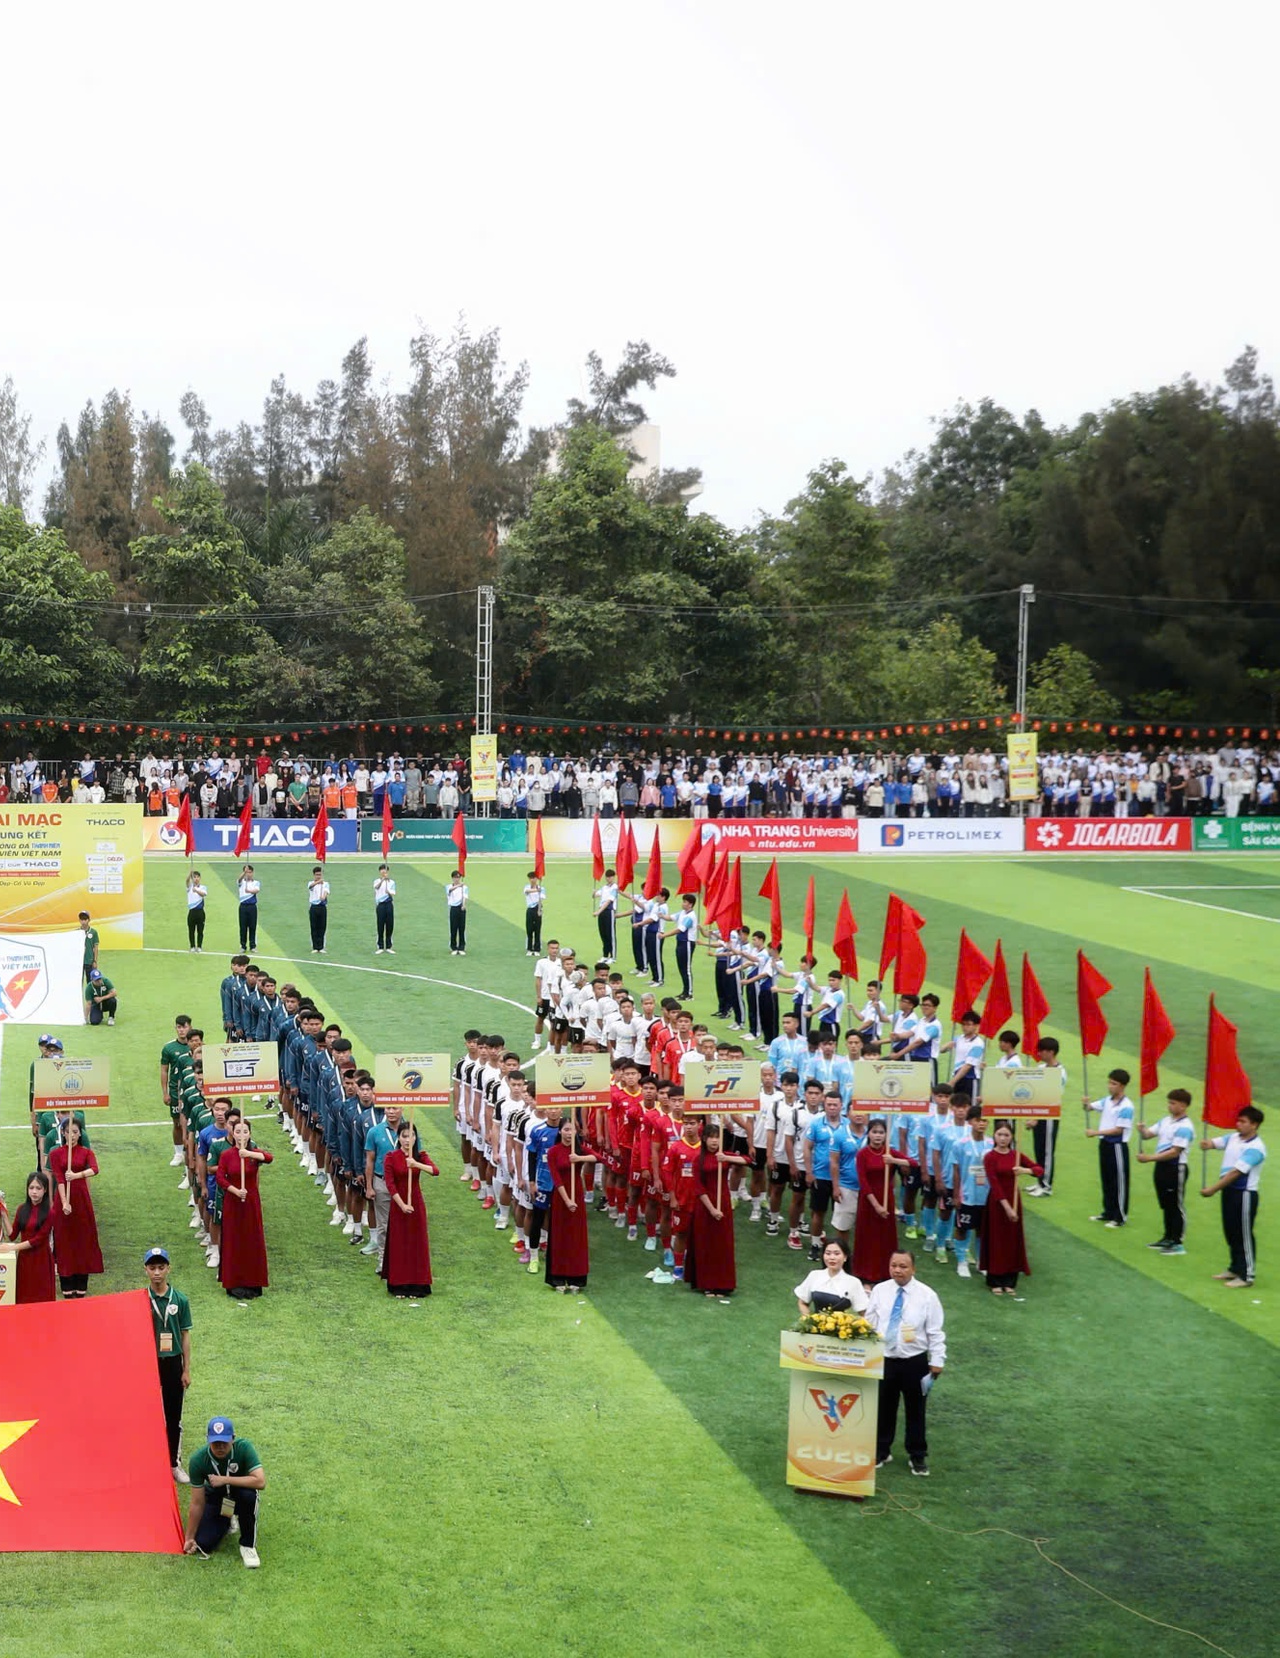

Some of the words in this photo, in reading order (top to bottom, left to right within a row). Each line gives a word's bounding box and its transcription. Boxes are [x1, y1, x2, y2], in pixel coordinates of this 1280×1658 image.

[18, 814, 62, 828] MẠC
[28, 830, 47, 838] KẾT
[372, 832, 395, 841] BIV
[722, 825, 751, 837] NHA
[753, 825, 800, 837] TRANG
[803, 825, 857, 839] University
[908, 831, 1001, 840] PETROLIMEX
[1067, 823, 1179, 845] JOGARBOLA
[758, 840, 815, 848] ntu.edu.vn
[961, 1214, 972, 1224] 22
